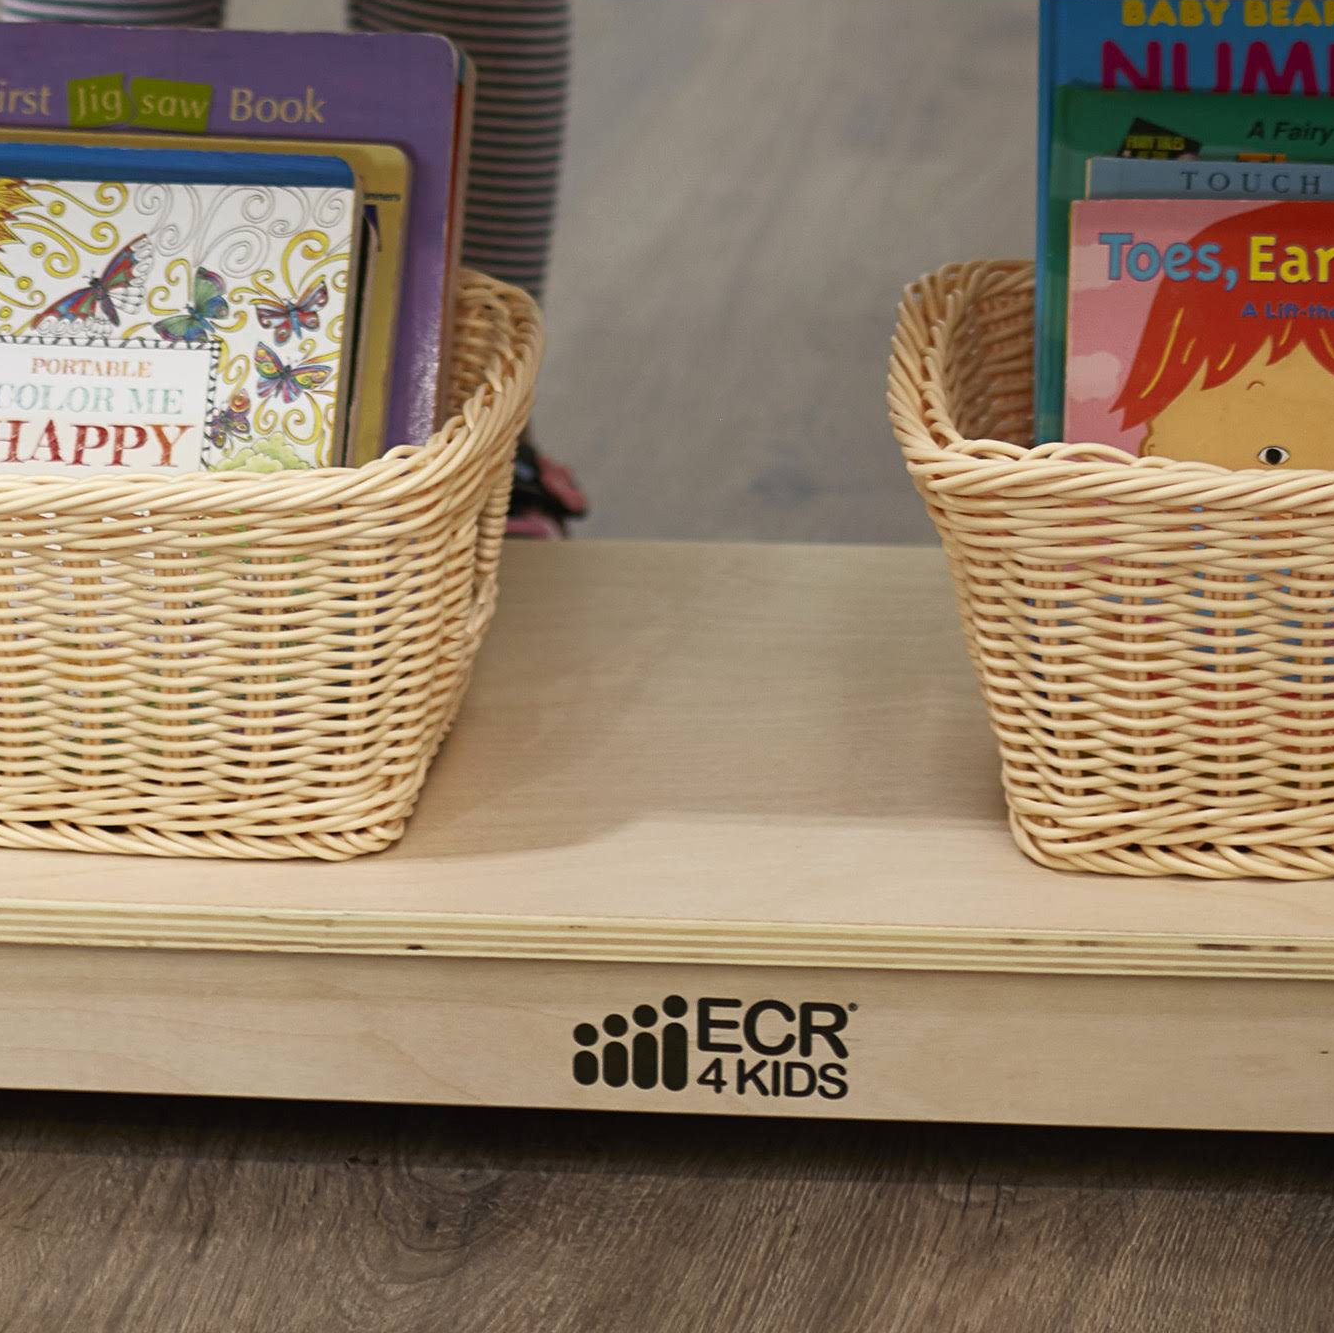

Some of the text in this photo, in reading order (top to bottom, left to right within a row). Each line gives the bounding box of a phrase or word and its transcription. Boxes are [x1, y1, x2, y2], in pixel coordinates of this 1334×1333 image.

[229, 84, 328, 125] Book
[1246, 121, 1265, 140] A
[1273, 122, 1333, 146] Fairy
[1180, 170, 1323, 196] TOUCH
[1099, 233, 1239, 291] Toes,
[1242, 302, 1257, 318] A
[31, 357, 152, 378] PORTABLE
[128, 387, 183, 415] ME
[697, 997, 849, 1059] ECR
[696, 1057, 849, 1100] 4 KIDS
